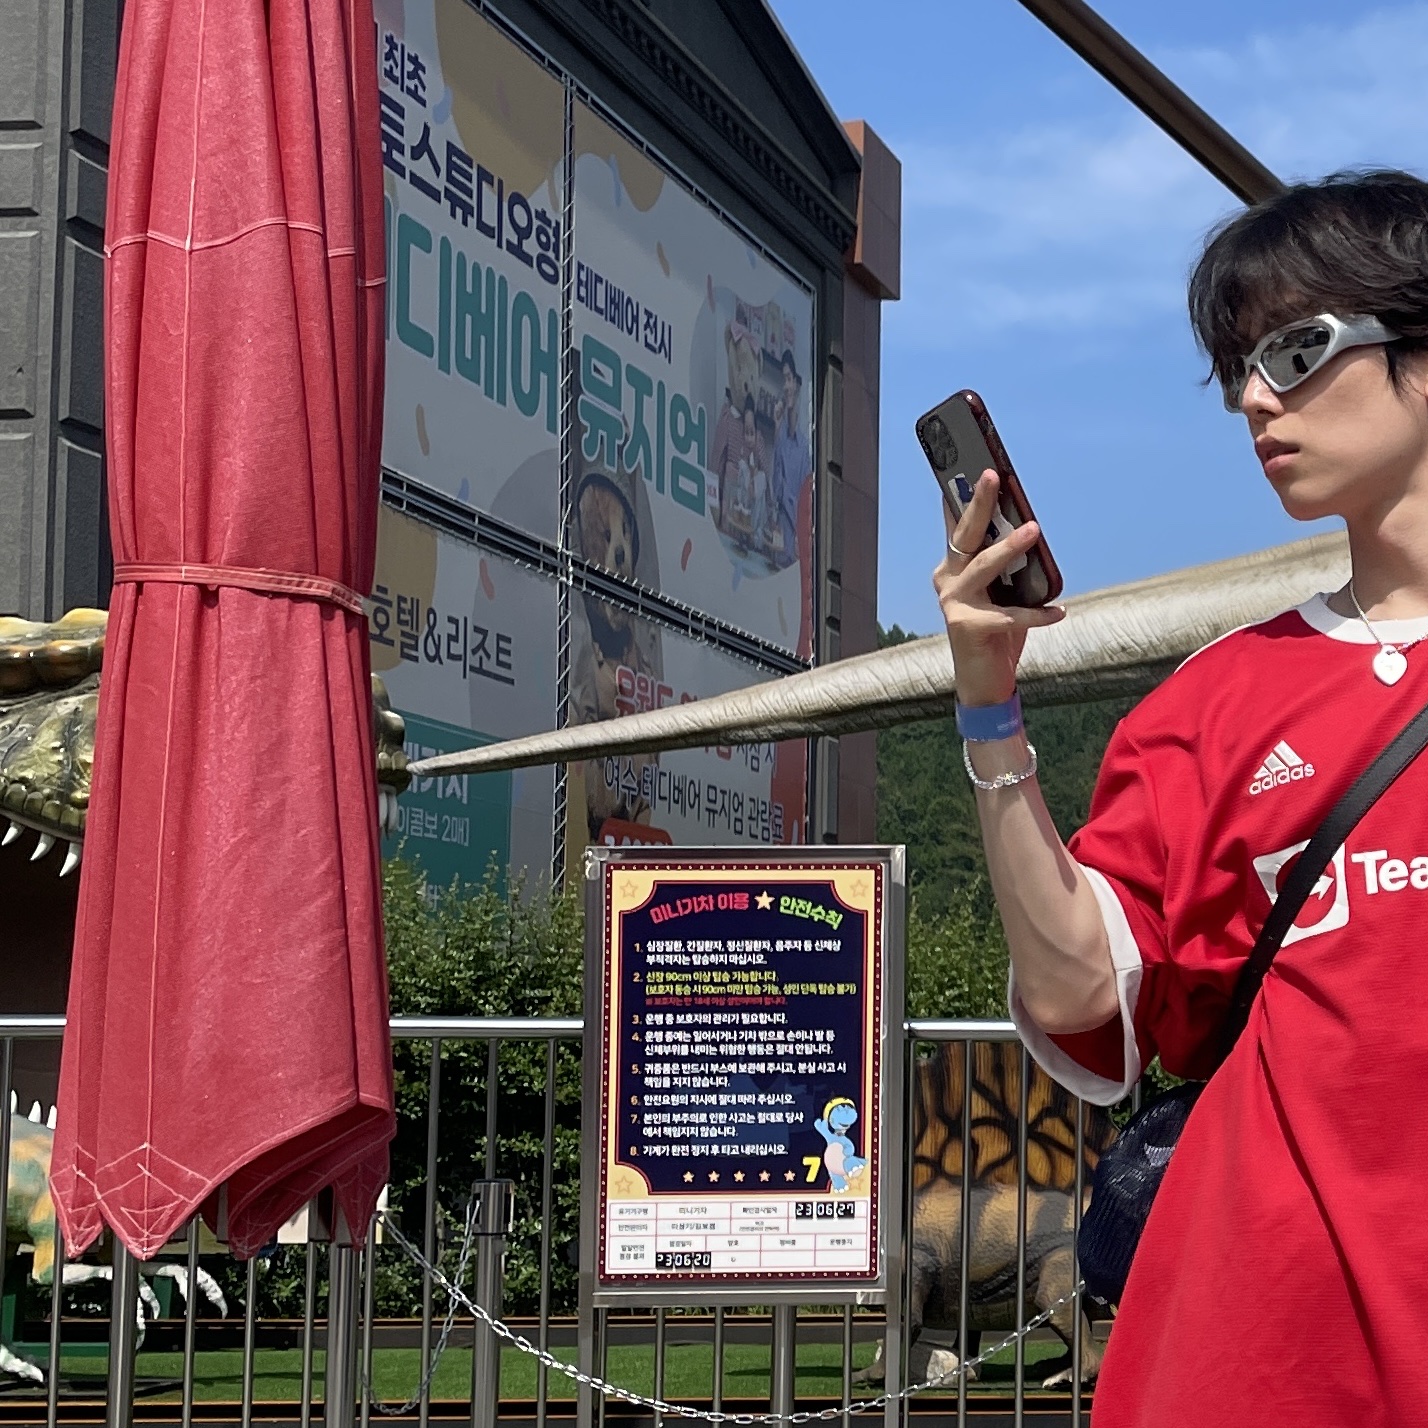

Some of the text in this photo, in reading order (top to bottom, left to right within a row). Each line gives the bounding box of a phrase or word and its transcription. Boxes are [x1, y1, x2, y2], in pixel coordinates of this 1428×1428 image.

[384, 33, 427, 108] 최초
[576, 260, 640, 342] 테디베어
[643, 307, 672, 365] 전시
[384, 196, 706, 518] 디베어 뮤지엄
[370, 584, 515, 686] 호텔&리조트
[1249, 763, 1315, 795] adidas
[603, 755, 783, 843] 여수 테디베어 뮤지엄 관람료
[649, 892, 844, 931] 미니기차 이용 안전수칙
[665, 971, 692, 982] 90cm
[702, 984, 726, 995] 90cm
[802, 1157, 821, 1183] 7
[796, 1203, 854, 1217] 23 06 27
[674, 1253, 692, 1267] 06
[693, 1253, 711, 1267] 20
